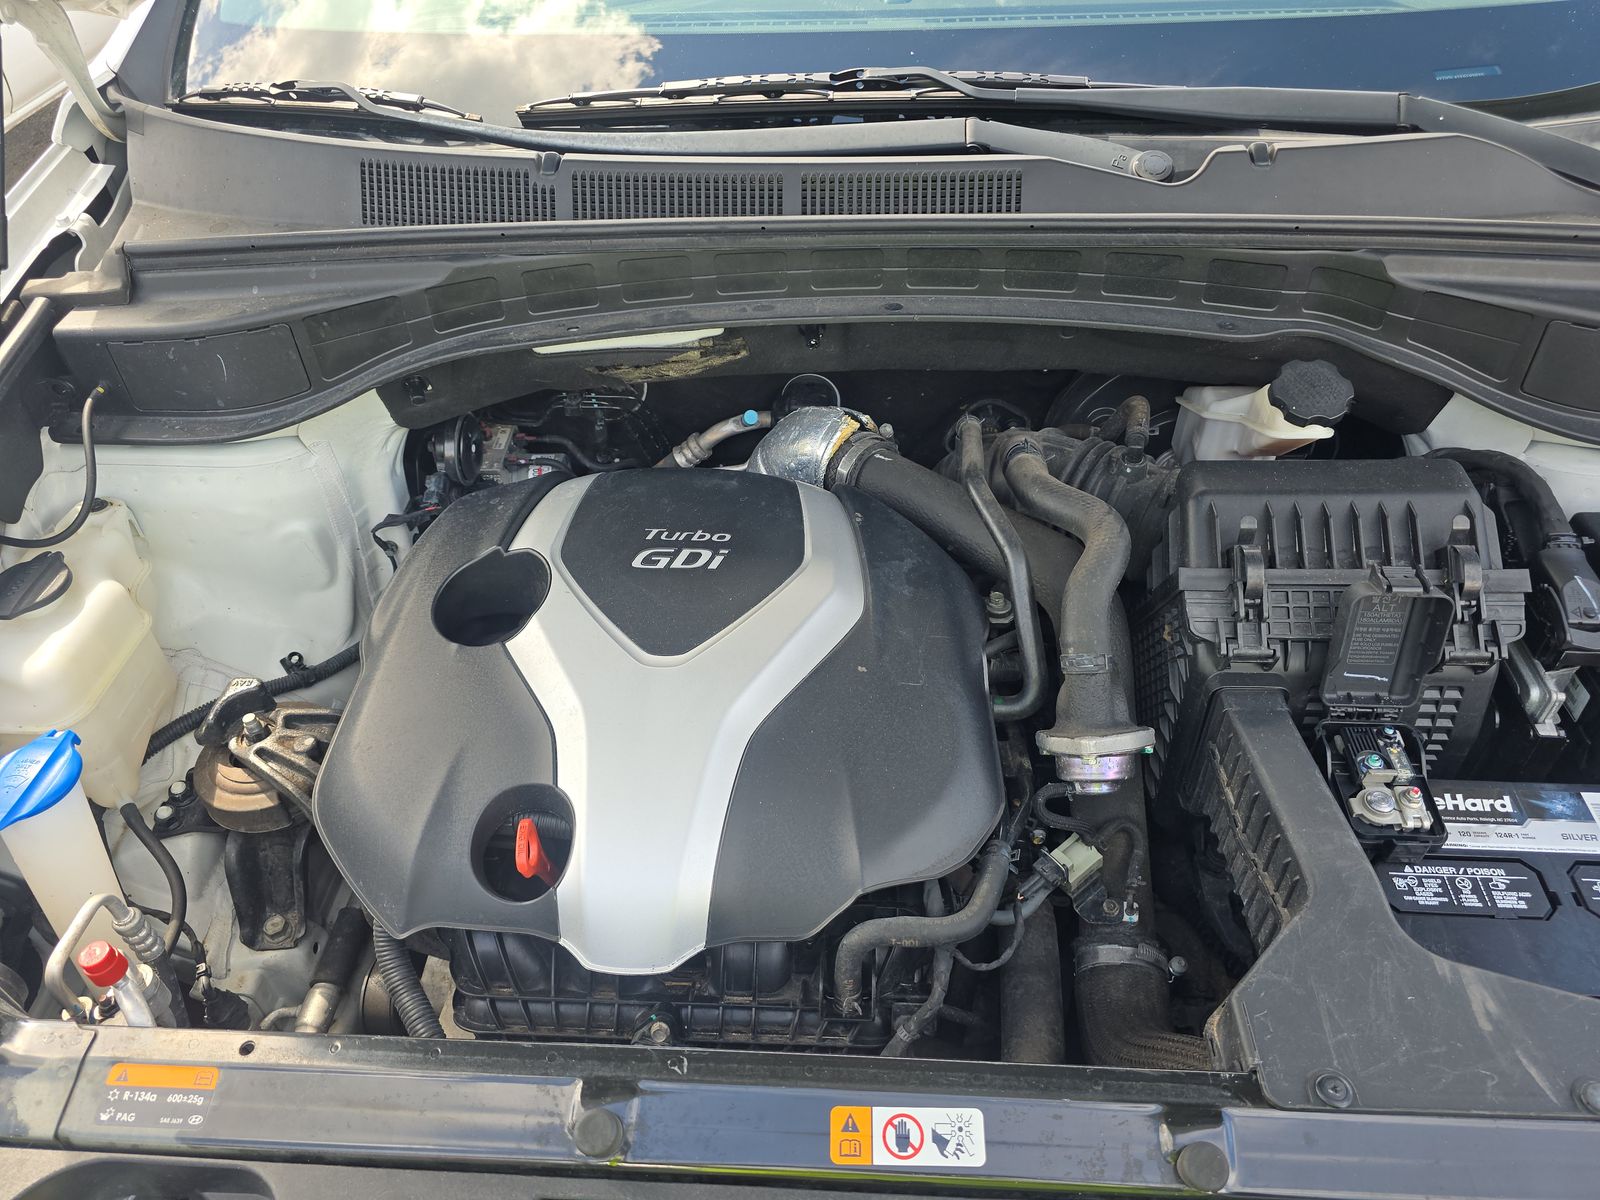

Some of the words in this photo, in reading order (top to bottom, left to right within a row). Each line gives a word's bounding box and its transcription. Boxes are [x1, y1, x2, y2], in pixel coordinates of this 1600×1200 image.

[645, 528, 732, 542] Turbo
[631, 547, 731, 569] GDi
[1561, 833, 1599, 842] SILVER
[1414, 866, 1458, 874] DANGER
[1466, 868, 1506, 876] POISON
[122, 1090, 158, 1102] R-134a
[166, 1094, 204, 1106] 600±25g
[116, 1112, 136, 1122] PAG
